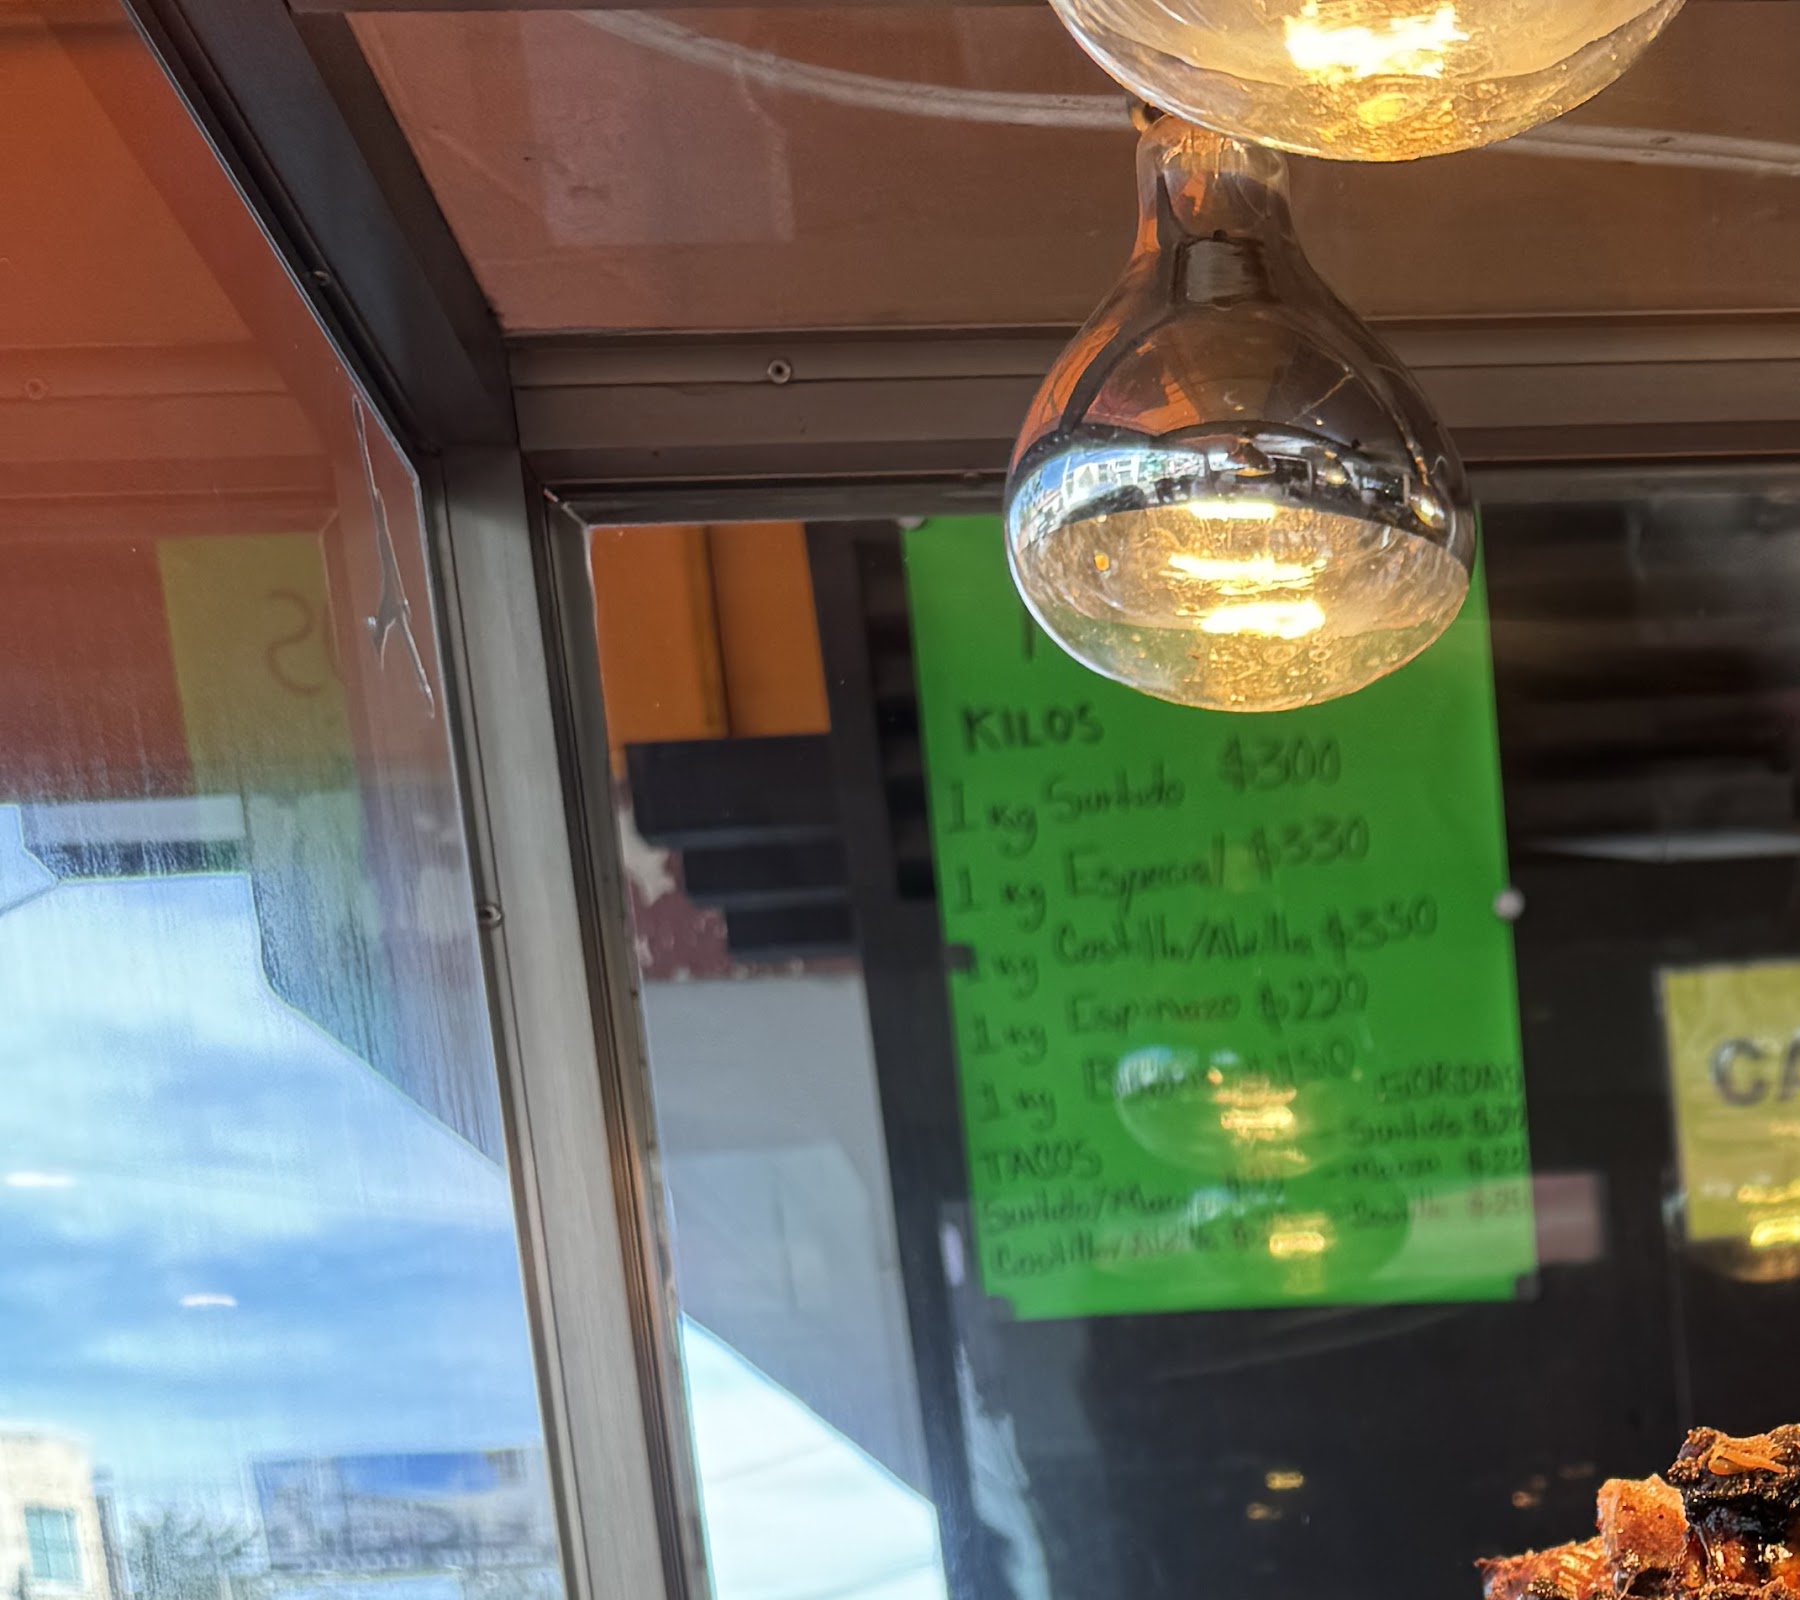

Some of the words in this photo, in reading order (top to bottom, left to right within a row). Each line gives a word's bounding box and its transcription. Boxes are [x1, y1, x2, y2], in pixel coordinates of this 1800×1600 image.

[961, 704, 1104, 754] KILOS
[1221, 733, 1340, 791] $300
[1252, 817, 1369, 881] $330
[982, 1140, 1102, 1180] TACOS
